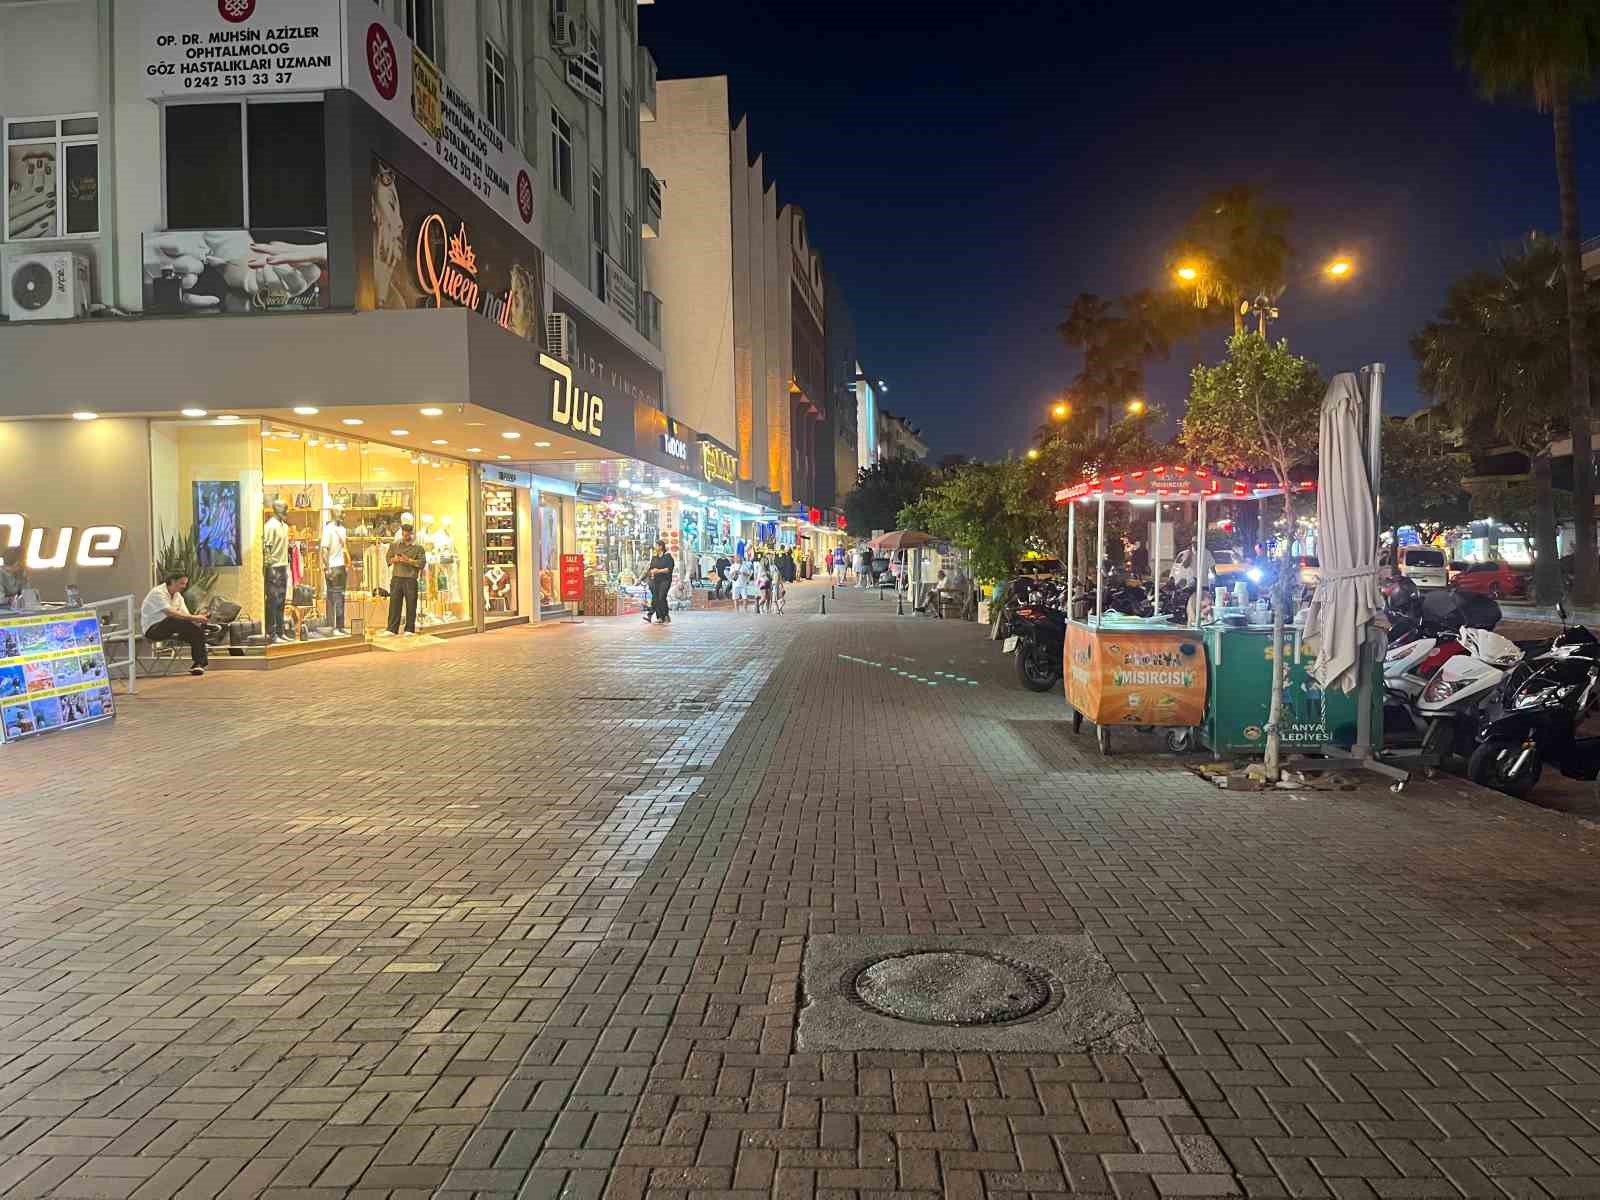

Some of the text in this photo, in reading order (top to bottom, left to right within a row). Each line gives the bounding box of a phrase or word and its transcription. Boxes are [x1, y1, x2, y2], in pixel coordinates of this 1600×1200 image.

[156, 26, 319, 47] OP. DR. MUHSİN AZİZLER
[186, 43, 290, 59] OPHTALMOLOG
[146, 56, 331, 76] GÖZ HASTALIKLARI UZMANI
[224, 74, 246, 86] 513
[252, 73, 269, 84] 33
[275, 72, 292, 84] 37
[440, 100, 488, 156] PHTALMOLOG
[416, 213, 480, 311] Queen
[539, 353, 603, 437] Due
[1280, 731, 1333, 742] LEDİYESİ
[1291, 723, 1325, 732] ANYA
